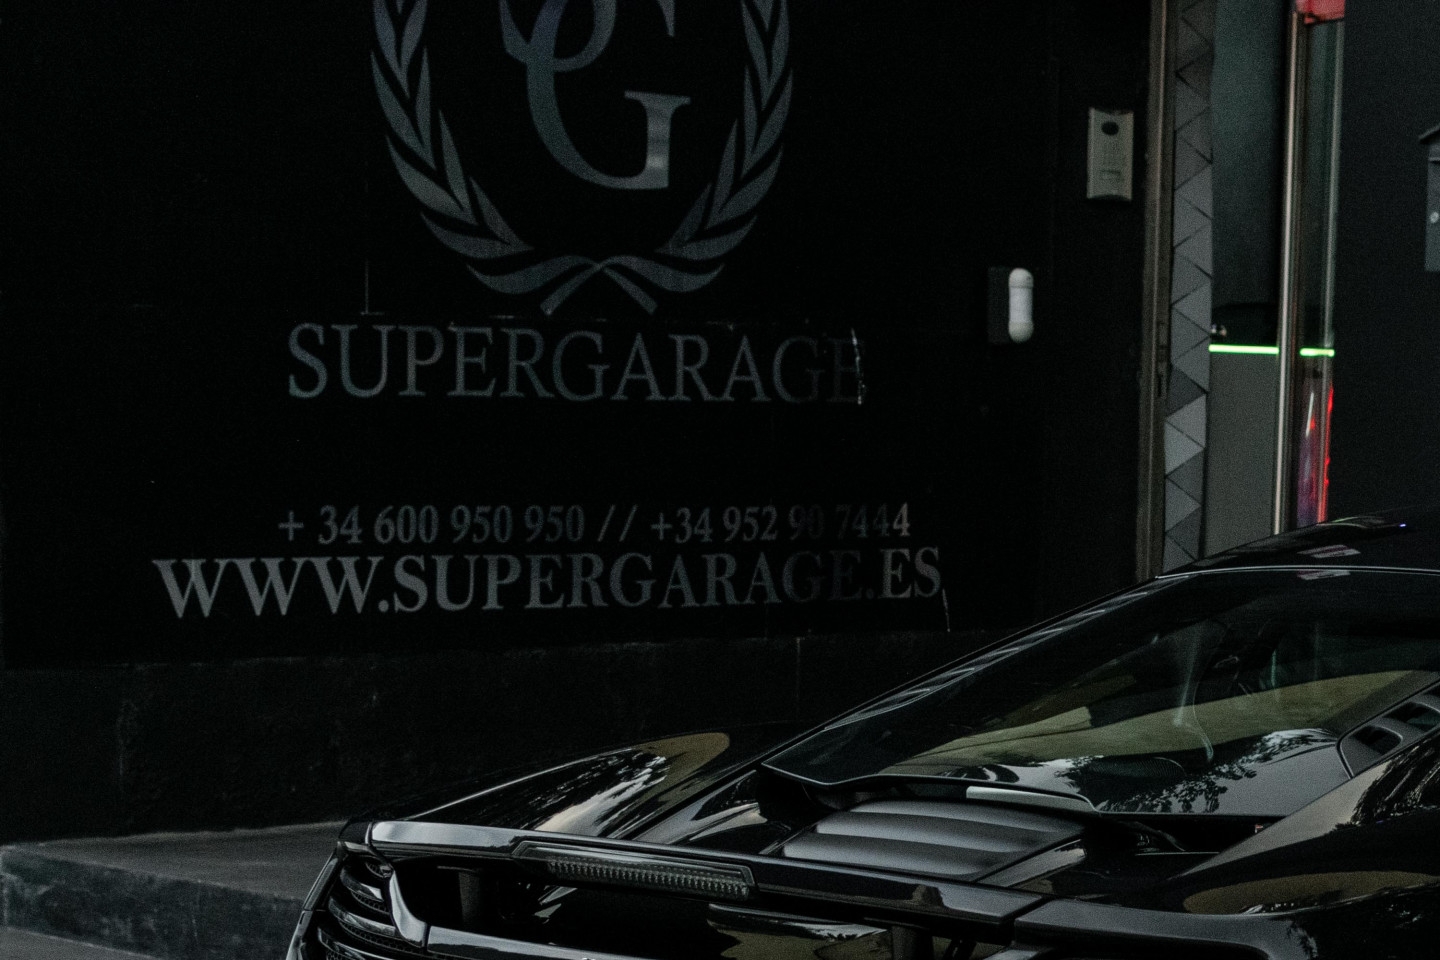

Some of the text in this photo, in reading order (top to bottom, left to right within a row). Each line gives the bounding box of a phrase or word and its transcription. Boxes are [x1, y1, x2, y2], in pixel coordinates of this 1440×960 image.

[287, 321, 866, 404] SUPERGARAGE
[317, 504, 364, 545] 34
[373, 504, 439, 544] 600
[449, 504, 514, 544] 950
[523, 504, 586, 543] 950
[650, 505, 714, 544] +34
[722, 504, 780, 543] 952
[787, 503, 826, 542] 90
[834, 501, 912, 541] 7444
[150, 544, 942, 619] WWW.SUPERGARAGE.ES
